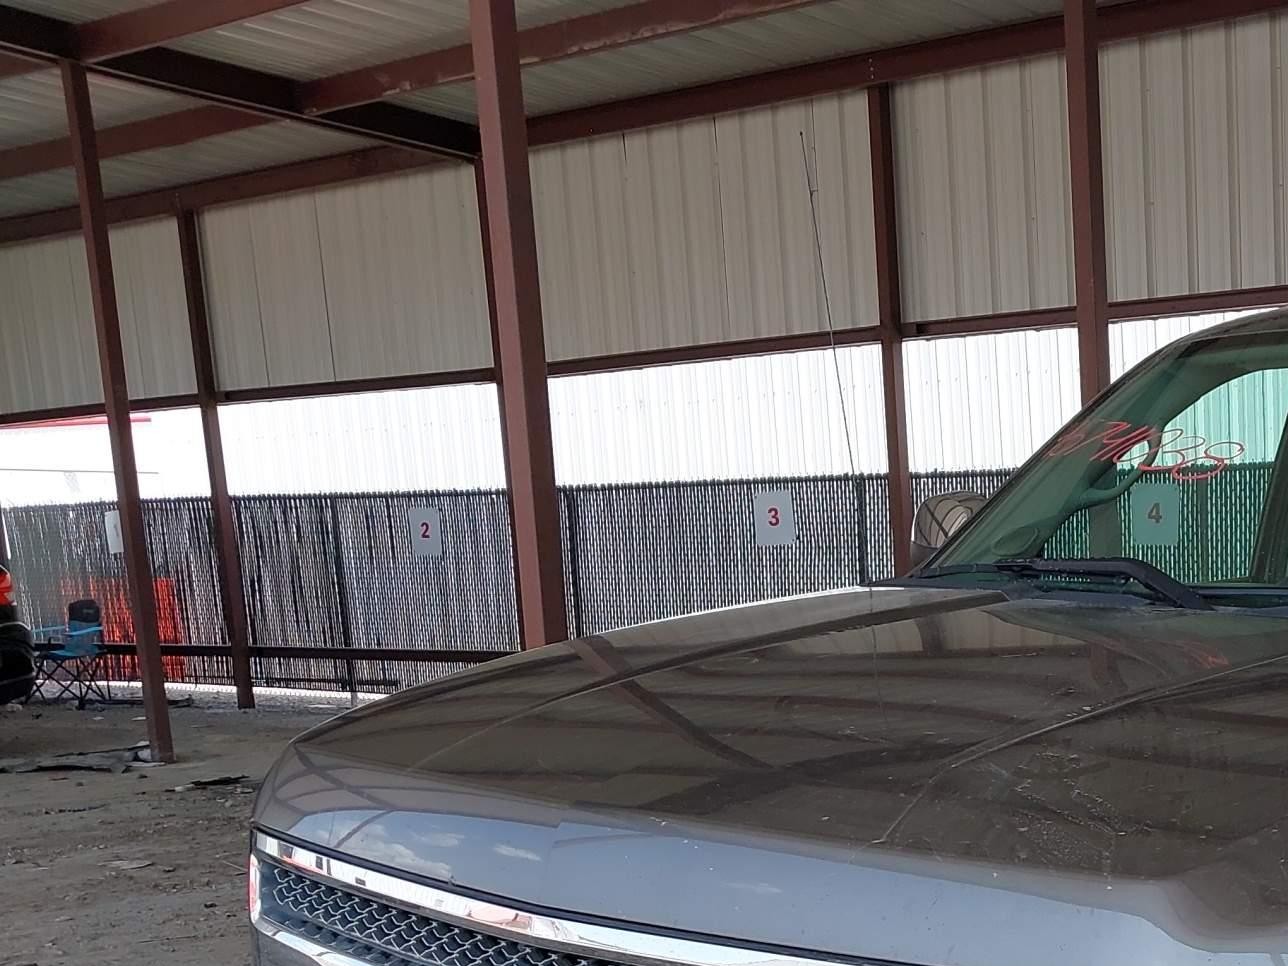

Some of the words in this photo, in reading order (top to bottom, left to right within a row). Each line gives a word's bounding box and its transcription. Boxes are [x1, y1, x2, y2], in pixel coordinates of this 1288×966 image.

[767, 507, 780, 526] 3
[1147, 502, 1162, 524] 4
[420, 521, 430, 539] 2
